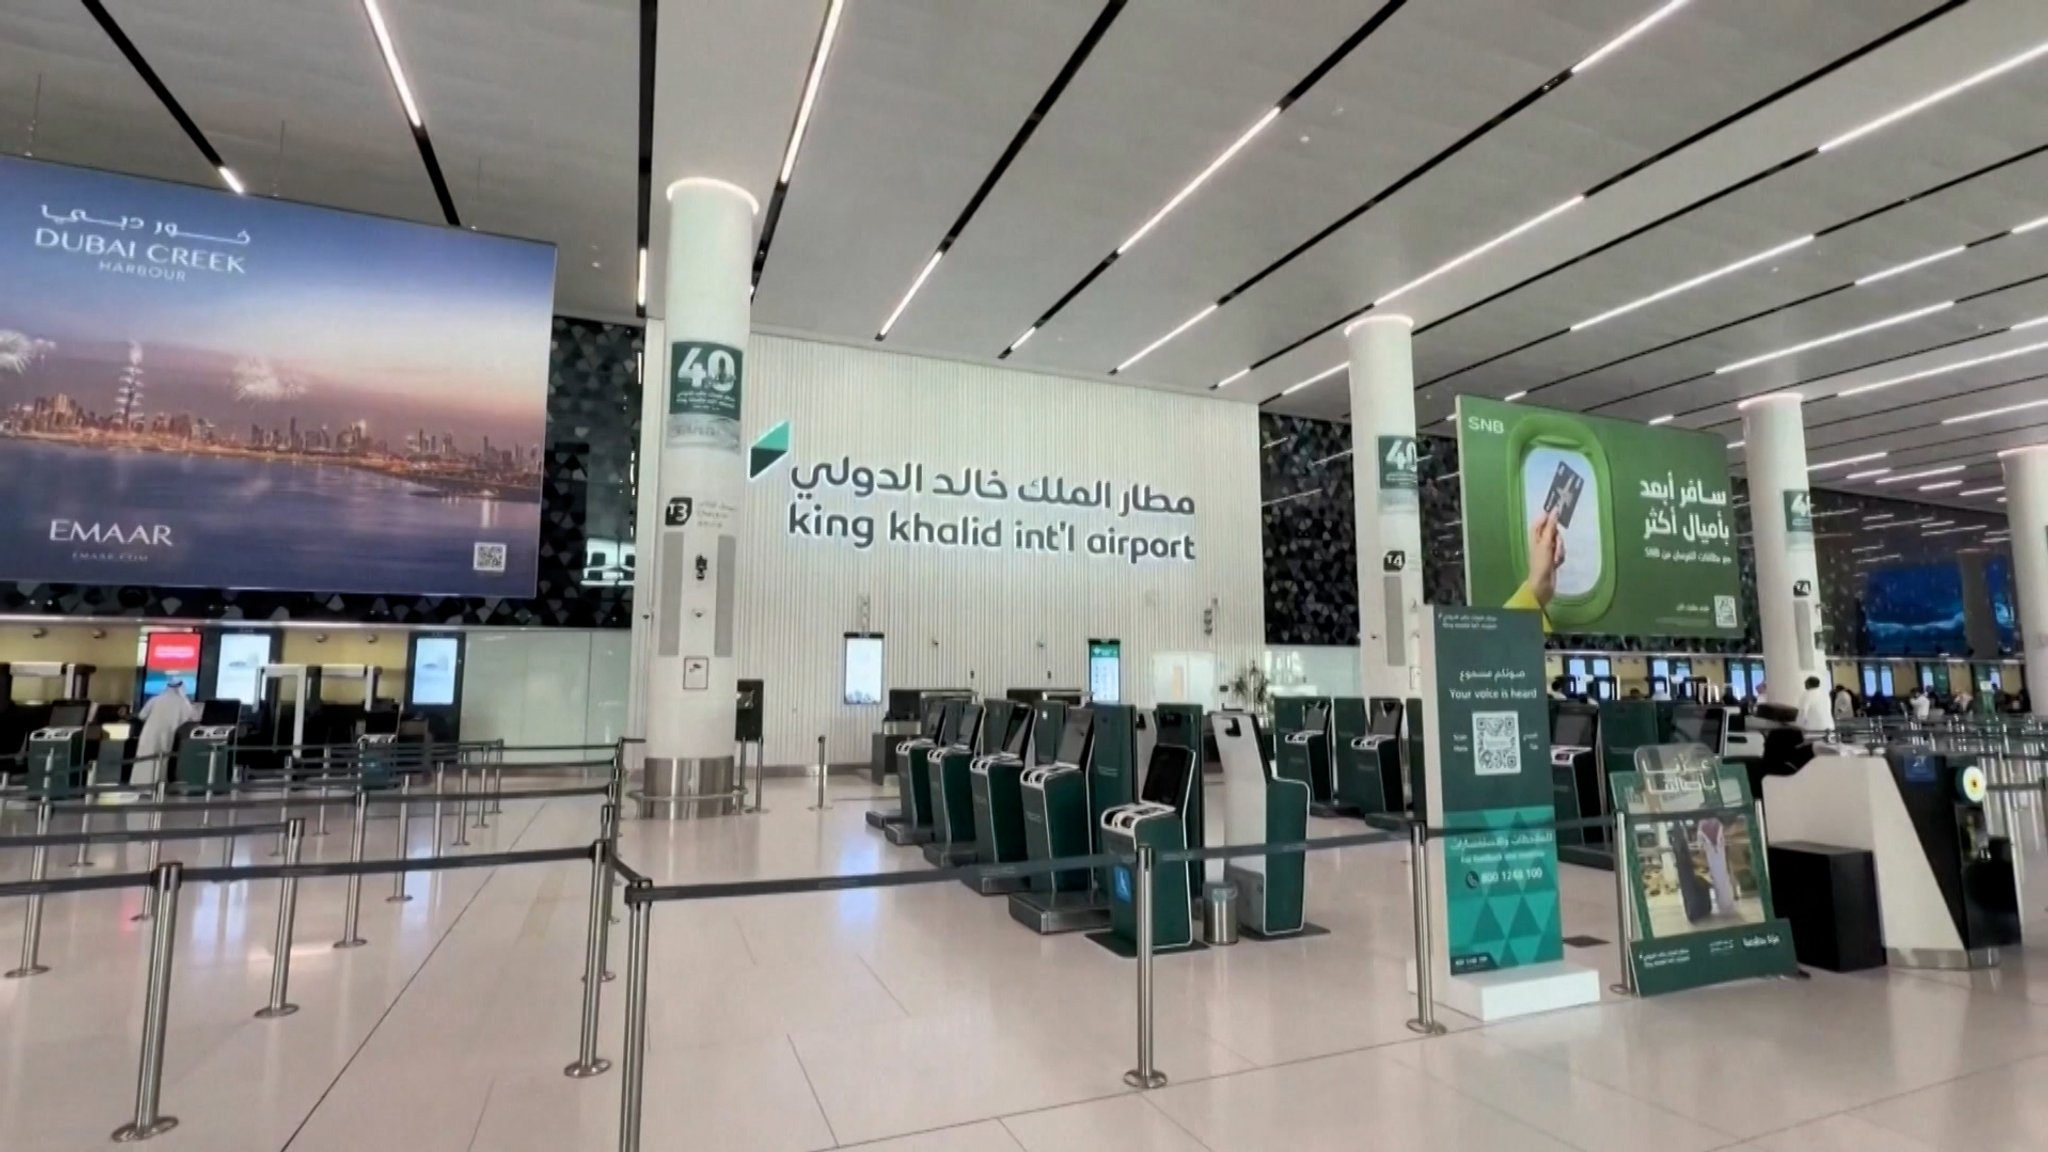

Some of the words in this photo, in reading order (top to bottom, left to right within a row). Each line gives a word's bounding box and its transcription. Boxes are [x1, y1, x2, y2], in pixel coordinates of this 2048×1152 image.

[35, 227, 136, 259] DUBAI
[146, 243, 246, 275] CREEK
[100, 259, 187, 282] HARBOUR
[677, 347, 736, 392] 40
[1468, 415, 1504, 434] SNB
[791, 455, 922, 500] الدولي
[932, 467, 1008, 500] خالد
[1017, 475, 1111, 508] الملك
[1639, 469, 1675, 507] أبعد
[1678, 478, 1727, 509] سافر
[1118, 482, 1195, 518] مطار
[50, 518, 174, 547] EMAAR
[789, 502, 874, 549] king
[889, 510, 1002, 547] khalid
[1014, 519, 1075, 551] int'l
[1087, 526, 1196, 564] airport
[1643, 505, 1678, 540] أكثر
[1682, 510, 1730, 547] بأميال
[1449, 689, 1472, 699] Your
[1474, 688, 1499, 699] voice
[1501, 688, 1510, 699] is
[1510, 688, 1538, 699] heard
[1526, 866, 1543, 880] 100
